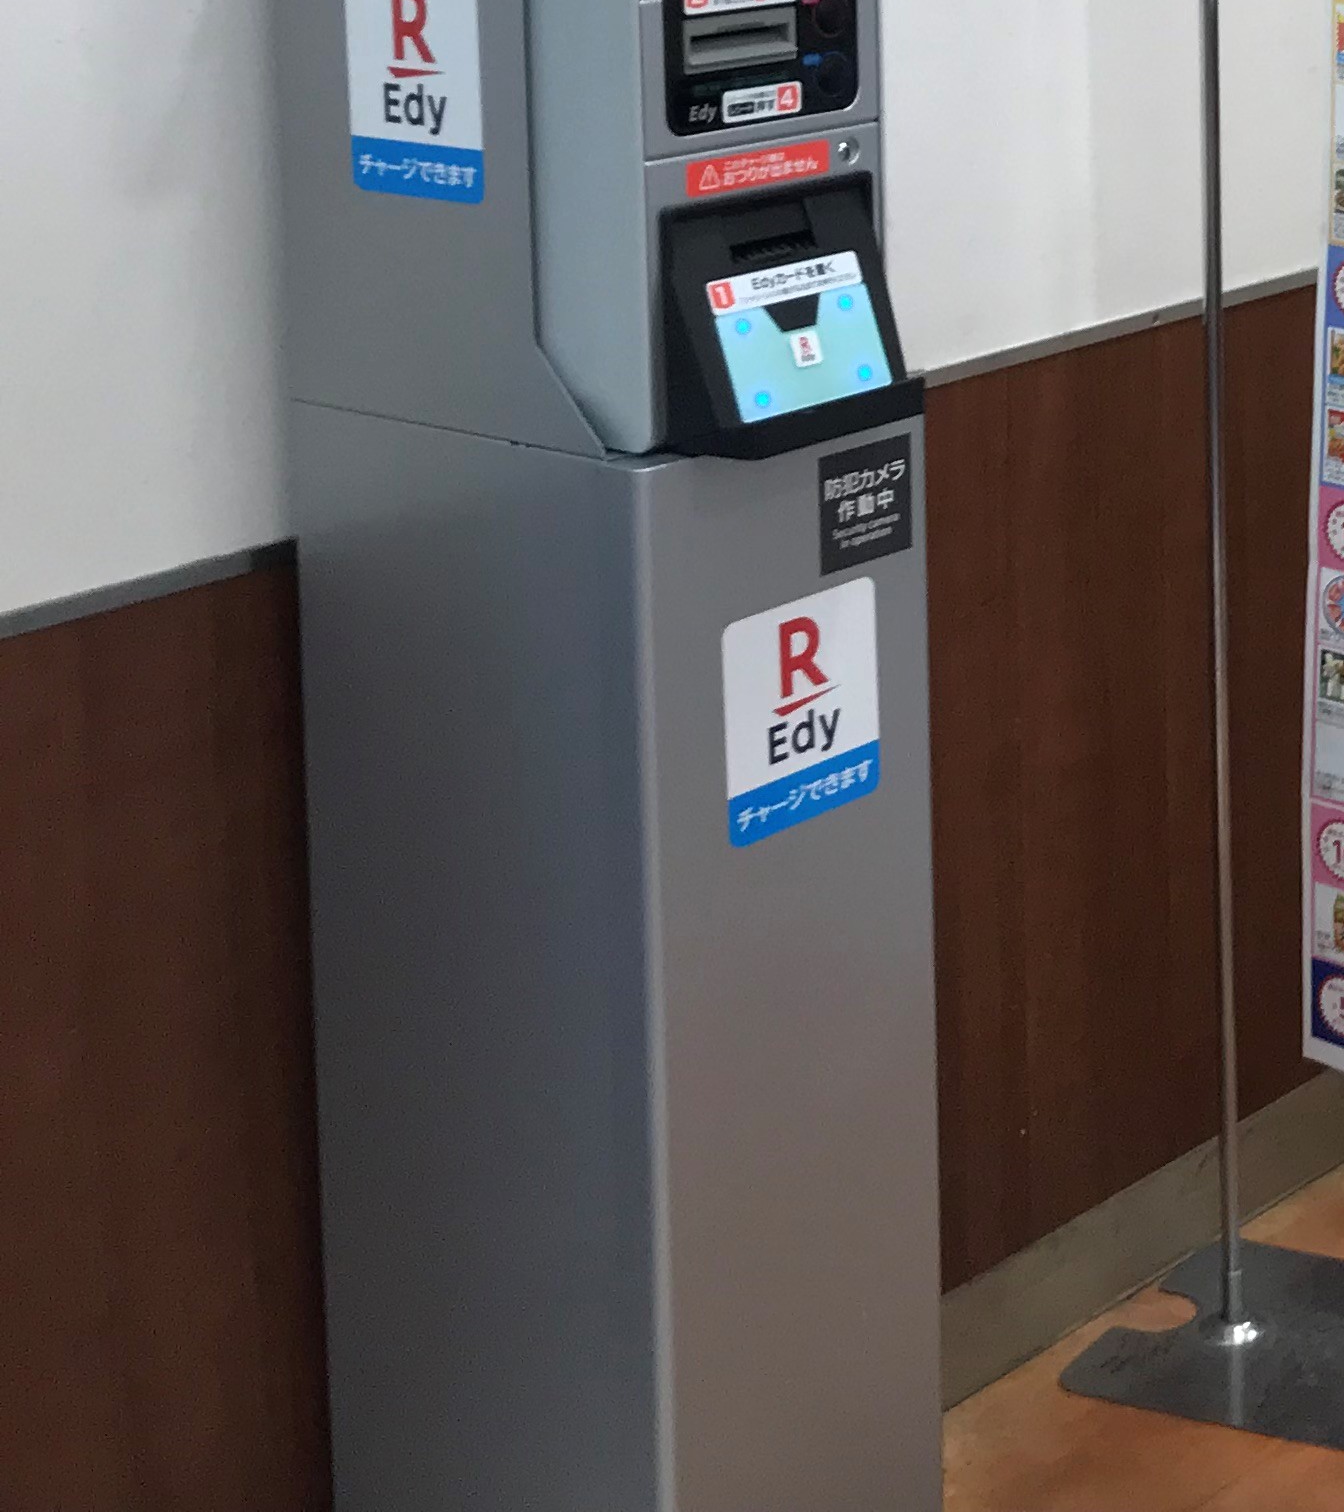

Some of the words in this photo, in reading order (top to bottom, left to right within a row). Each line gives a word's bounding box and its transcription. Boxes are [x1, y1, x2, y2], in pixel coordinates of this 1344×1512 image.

[383, 83, 448, 135] Edy
[689, 104, 716, 123] Edy
[780, 89, 792, 106] 4
[358, 153, 478, 189] チャージできます
[714, 285, 729, 305] 1
[824, 459, 905, 500] 防犯カメラ
[837, 488, 895, 524] 作動中
[778, 616, 829, 699] R
[767, 706, 841, 766] Edy
[736, 758, 873, 832] チャージできます
